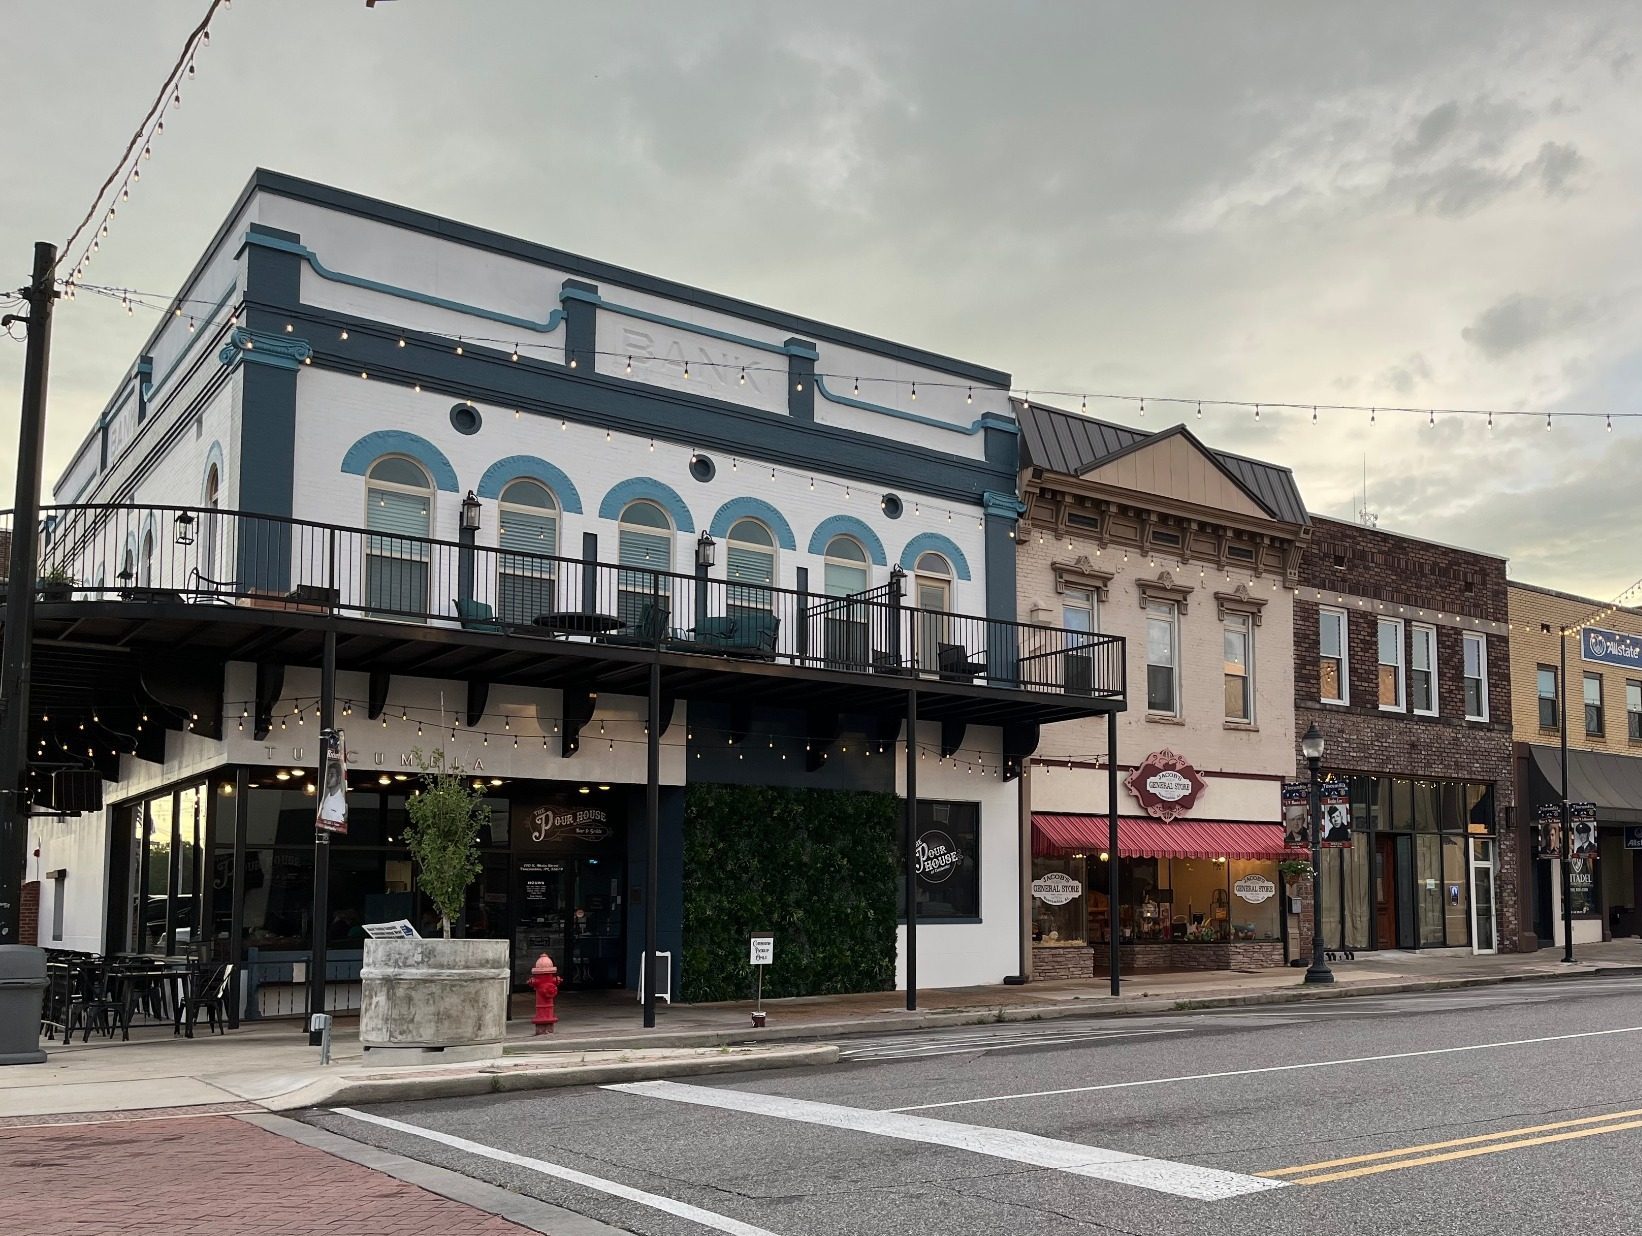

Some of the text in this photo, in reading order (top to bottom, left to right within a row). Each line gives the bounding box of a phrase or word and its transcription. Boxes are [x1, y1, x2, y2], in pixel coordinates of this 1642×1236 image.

[622, 327, 762, 394] BANK
[1607, 641, 1640, 659] Allstate
[1158, 772, 1182, 781] JACOB'S
[1149, 781, 1190, 791] GENERAL STORE
[532, 809, 607, 842] POUR HOUSE
[924, 851, 958, 872] HOUSE
[1043, 873, 1071, 883] JACOB'S
[1243, 875, 1266, 884] JACOB'S
[1570, 873, 1593, 883] ITADEL
[1033, 884, 1080, 893] GENERAL STORE
[1235, 884, 1274, 893] GENERAL STORE
